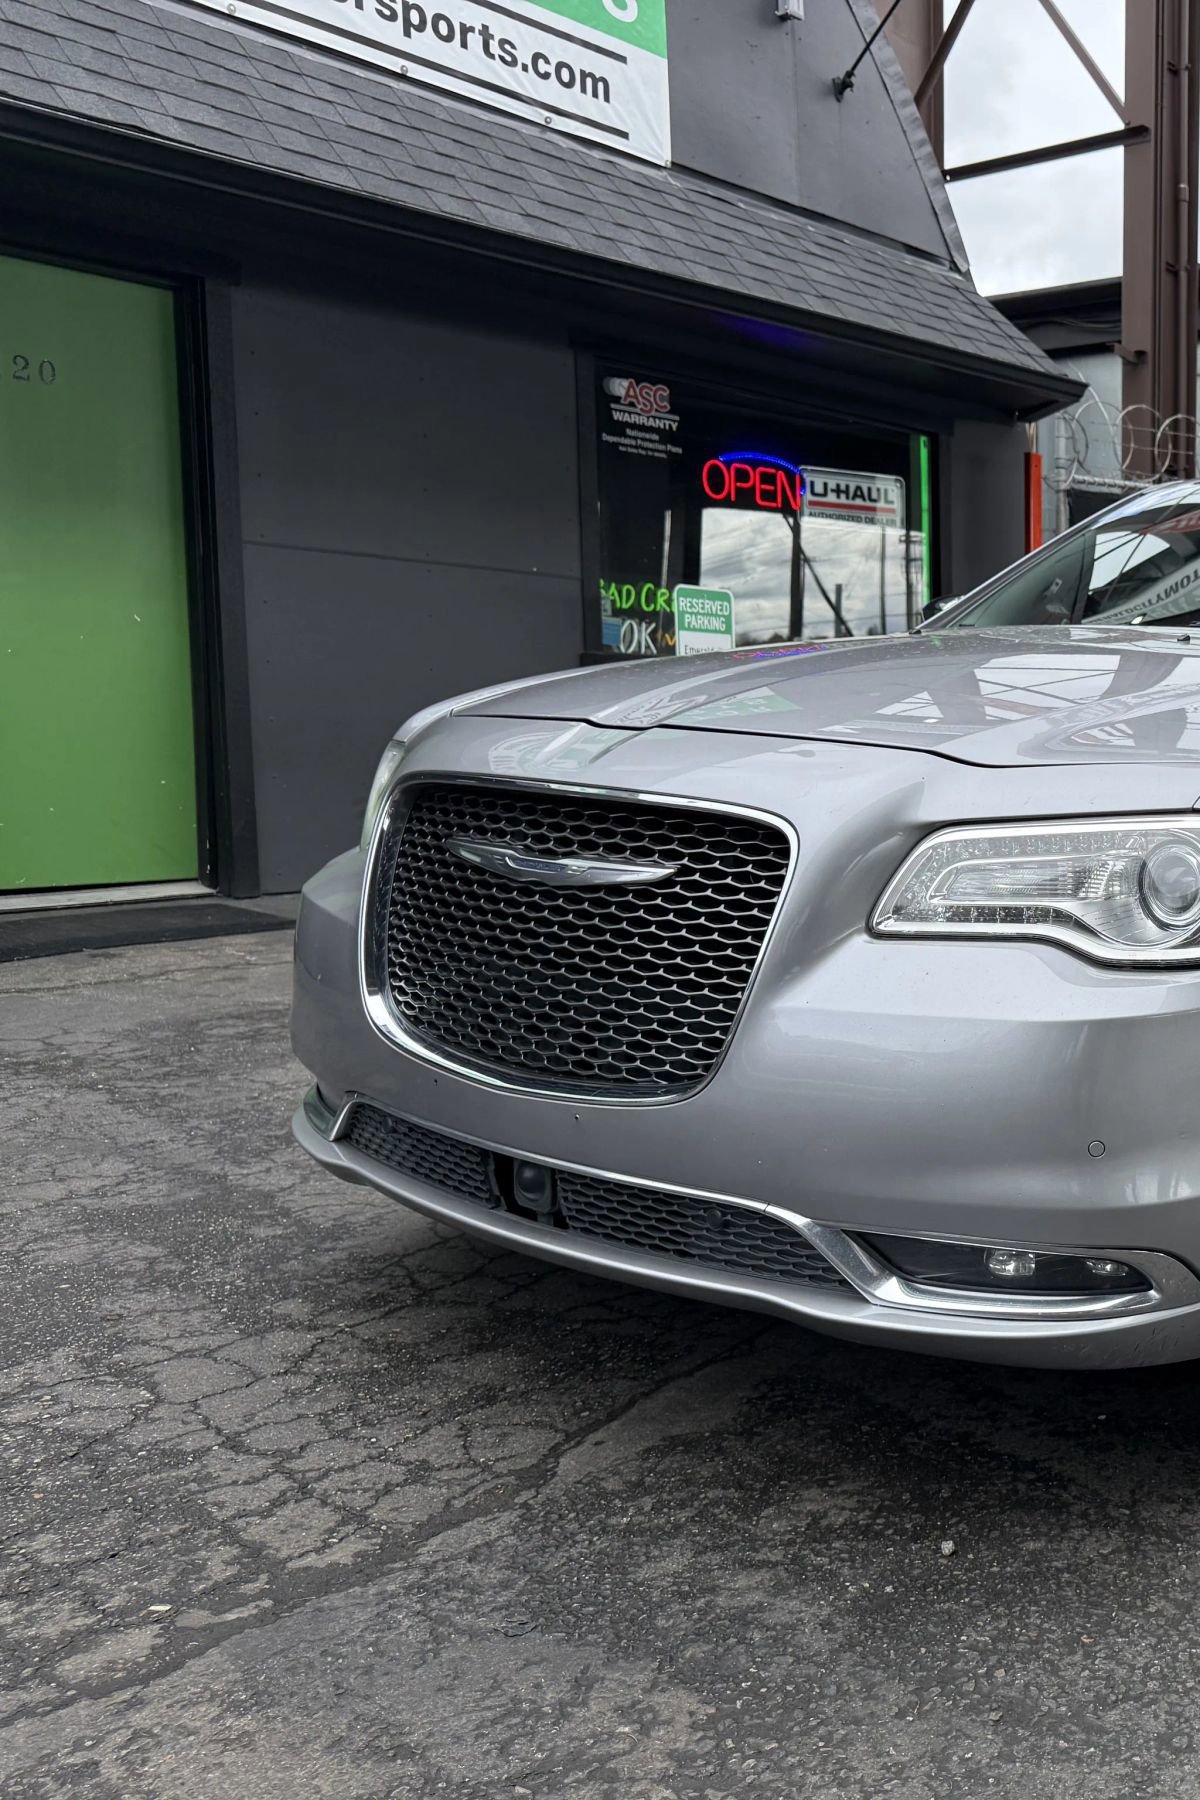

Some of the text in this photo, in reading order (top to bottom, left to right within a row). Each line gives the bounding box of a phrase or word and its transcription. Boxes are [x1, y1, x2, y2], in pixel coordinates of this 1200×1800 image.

[334, 0, 610, 104] sports.com
[620, 378, 671, 416] ASC
[611, 410, 678, 432] WARRANTY
[702, 459, 801, 511] OPEN
[809, 480, 895, 505] U-HAUL
[808, 511, 897, 527] AUTHORIZED DEALER
[640, 583, 676, 613] CR
[679, 597, 730, 616] RESERVED
[684, 615, 726, 632] PARKING
[620, 620, 658, 655] OK
